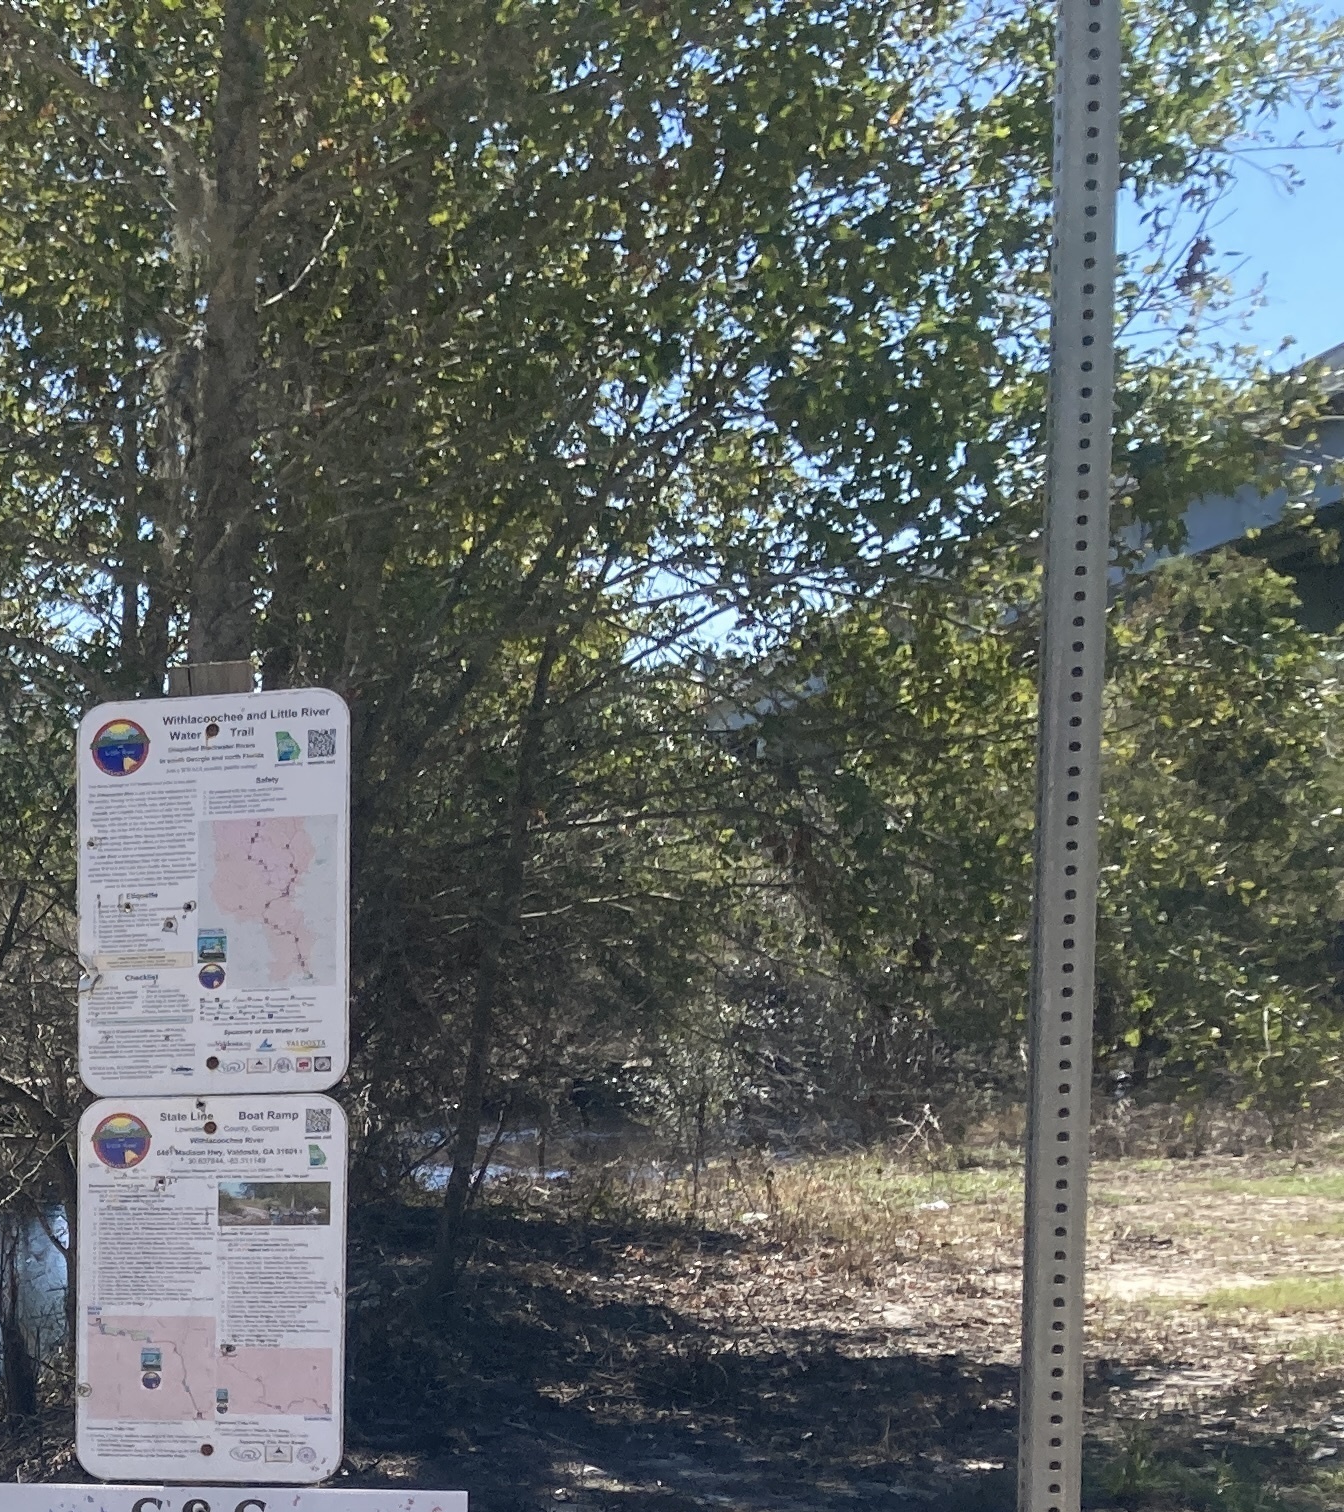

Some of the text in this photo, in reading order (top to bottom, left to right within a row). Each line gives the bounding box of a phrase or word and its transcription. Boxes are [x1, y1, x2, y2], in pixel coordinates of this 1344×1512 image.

[162, 707, 331, 726] Withlacoochee and Little River
[169, 727, 255, 741] Water Trail
[255, 776, 279, 784] Safety
[160, 1111, 299, 1122] State Line Boat Ramp
[251, 1125, 280, 1133] Georgia
